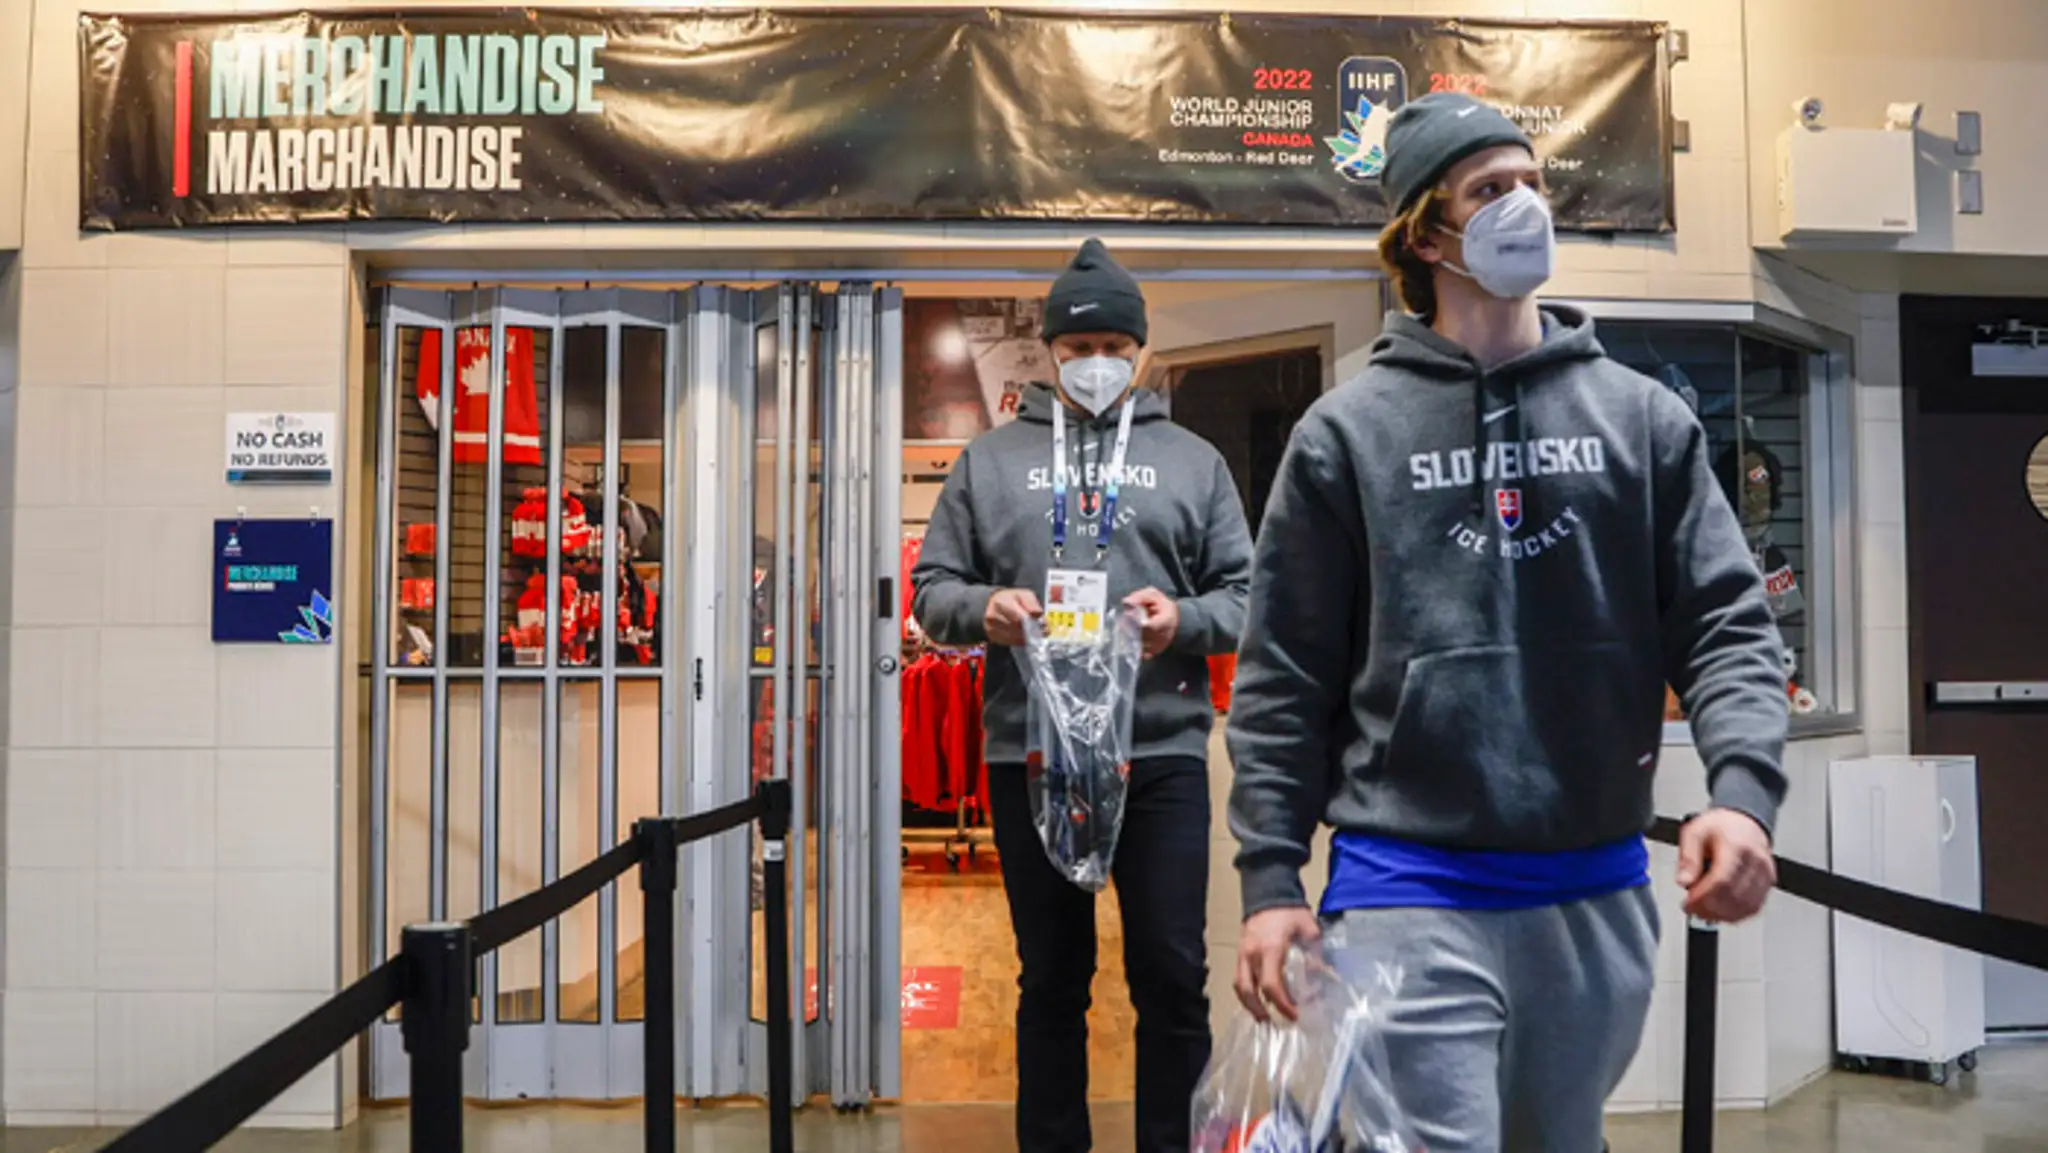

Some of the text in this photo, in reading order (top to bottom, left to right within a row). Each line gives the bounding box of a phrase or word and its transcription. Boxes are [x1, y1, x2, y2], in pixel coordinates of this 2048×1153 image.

[209, 34, 604, 118] MERCHANDISE
[1253, 68, 1312, 89] 2022
[1348, 72, 1396, 91] IIHF
[1429, 73, 1488, 94] 2022
[1170, 96, 1313, 115] WORLD JUNIOR
[1170, 112, 1313, 129] CHAMPIONSHIP
[1242, 131, 1314, 147] CANADA
[207, 125, 522, 194] MARCHANDISE
[1158, 148, 1233, 163] Edmonton
[1246, 151, 1275, 165] Red
[1278, 152, 1314, 165] Deer
[236, 432, 323, 448] NO CASH
[231, 453, 328, 466] NO REFUNDS
[1447, 505, 1581, 559] ICE HOCKEY
